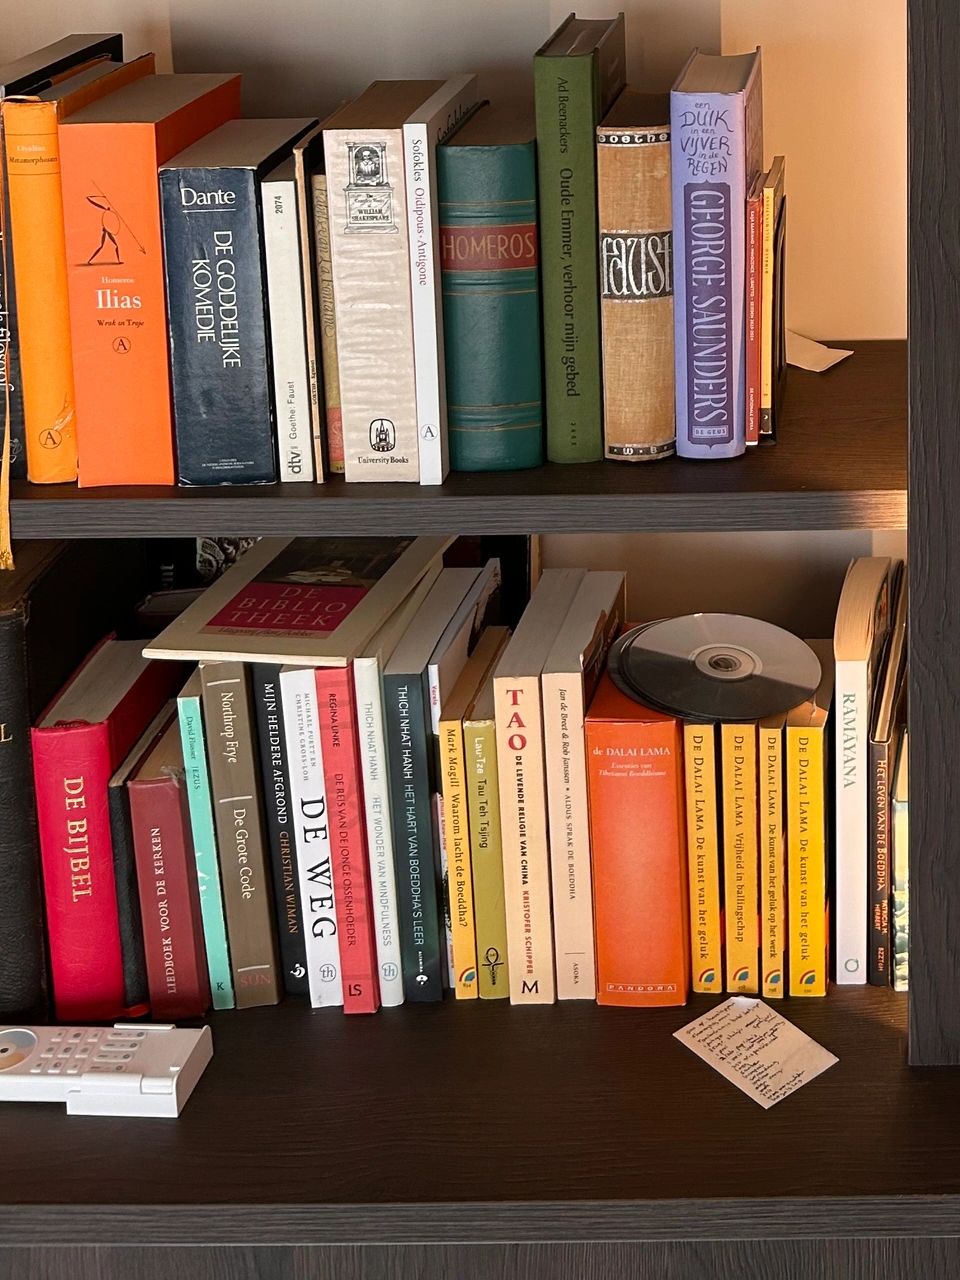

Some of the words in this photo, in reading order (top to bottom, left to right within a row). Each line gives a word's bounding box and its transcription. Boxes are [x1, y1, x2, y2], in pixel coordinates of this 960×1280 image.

[410, 137, 425, 183] Sofokles
[181, 188, 236, 205] Dante
[410, 186, 427, 235] Oidipous
[211, 229, 234, 257] DE
[443, 233, 535, 261] HOMEROS
[688, 188, 726, 287] GEORGE
[413, 238, 428, 287] Antigone
[96, 289, 142, 310] Ilias
[191, 259, 215, 342] KOMEDIE
[214, 257, 242, 369] GODDELIJKE
[690, 294, 728, 423] SAUNDERS
[219, 690, 238, 739] Northrop
[261, 682, 277, 712] MIJN
[221, 739, 240, 764] Frye
[266, 713, 283, 767] HELDERE
[606, 747, 637, 755] DALAI
[640, 746, 671, 755] LAMA
[62, 774, 87, 811] DE
[271, 767, 288, 825] AFGROND
[231, 807, 247, 827] De
[64, 816, 93, 903] BIJBEL
[149, 826, 165, 876] KERKEN
[233, 827, 249, 865] Grote
[277, 829, 295, 892] CHRISTIAN
[154, 878, 167, 896] DE
[237, 865, 256, 900] Code
[156, 897, 171, 932] VOOR
[284, 892, 299, 934] WIMAN
[160, 935, 177, 993] LIEDBOEK
[607, 983, 676, 991] PANDORA
